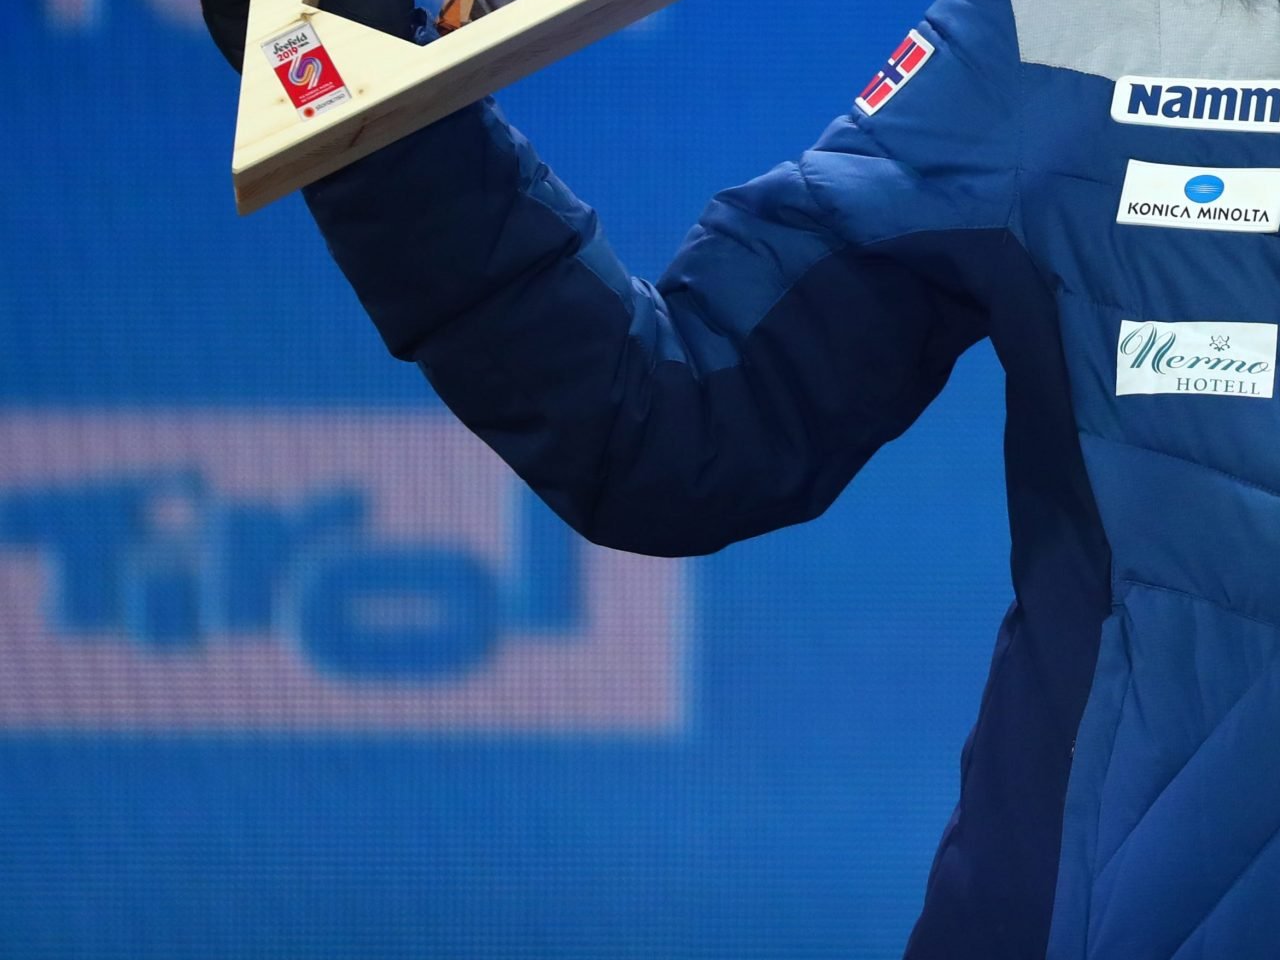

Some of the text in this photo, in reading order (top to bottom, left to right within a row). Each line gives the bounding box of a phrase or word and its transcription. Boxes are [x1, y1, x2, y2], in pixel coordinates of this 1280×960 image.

[277, 46, 299, 62] 2019
[1127, 202, 1270, 223] KONICA MINOLTA
[1119, 323, 1271, 375] Nermo
[1175, 377, 1261, 395] HOTELL
